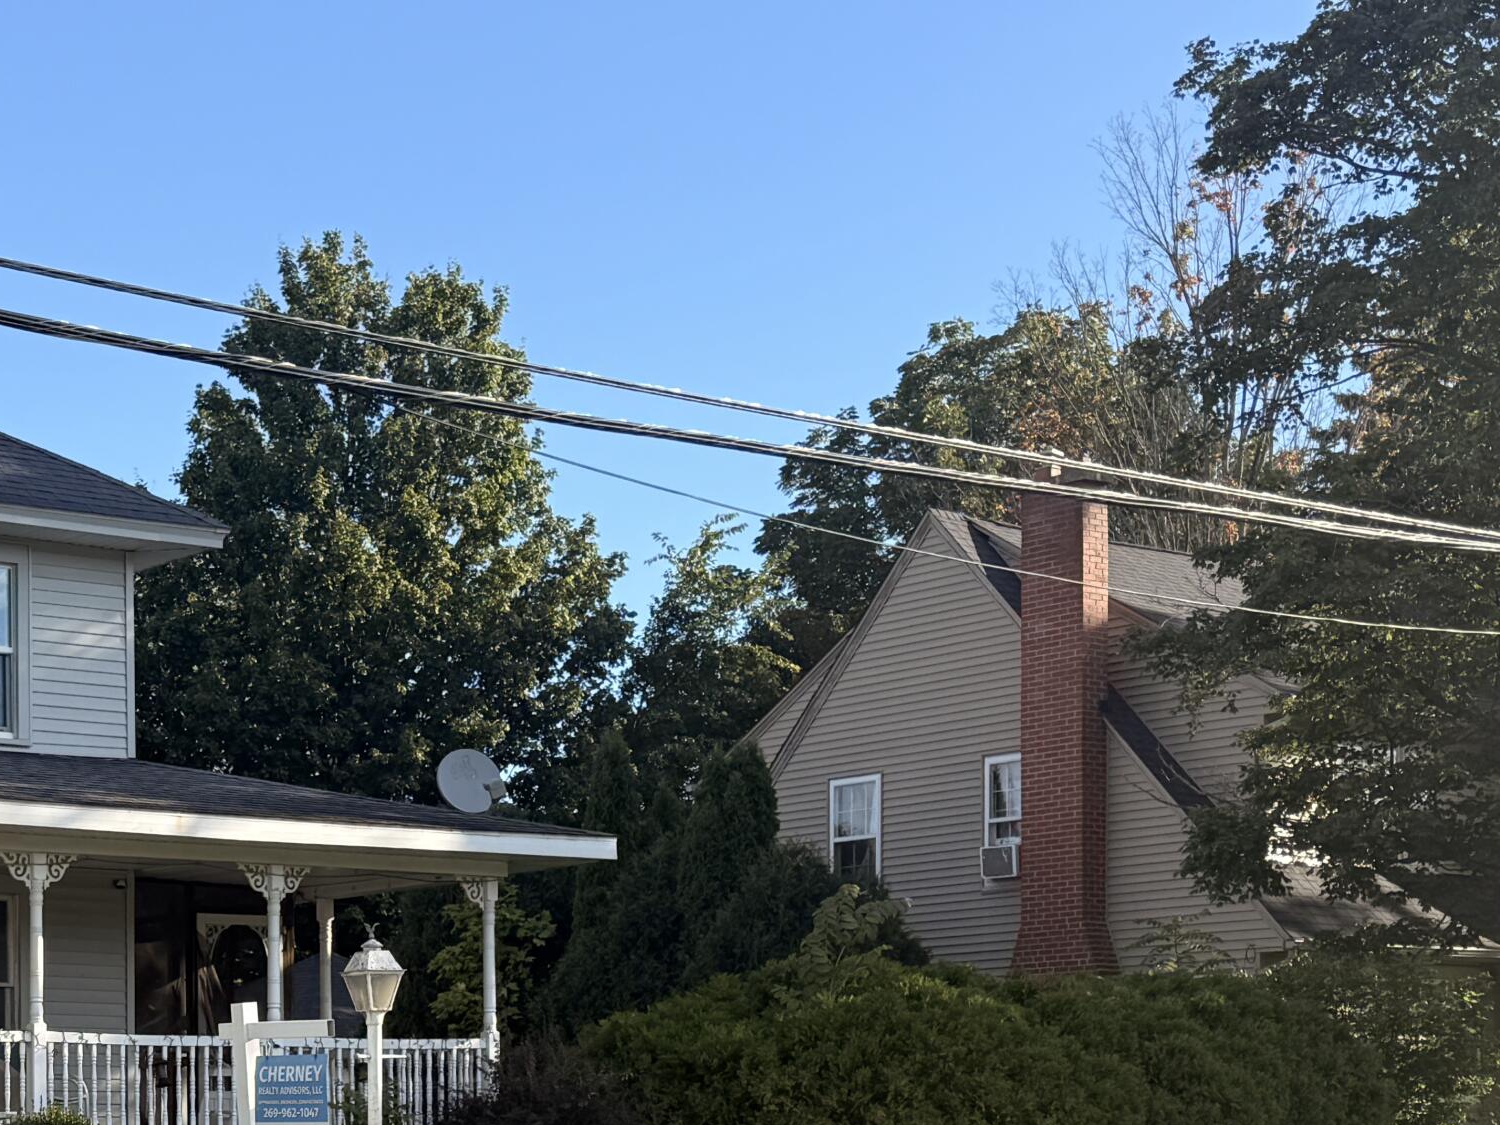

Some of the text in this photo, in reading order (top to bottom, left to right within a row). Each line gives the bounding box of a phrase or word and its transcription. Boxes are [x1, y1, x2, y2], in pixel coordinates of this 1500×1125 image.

[259, 1065, 323, 1083] CHERNEY
[259, 1085, 324, 1096] REALTY ADVISORS, LLC
[263, 1107, 319, 1118] 269-962-1047
